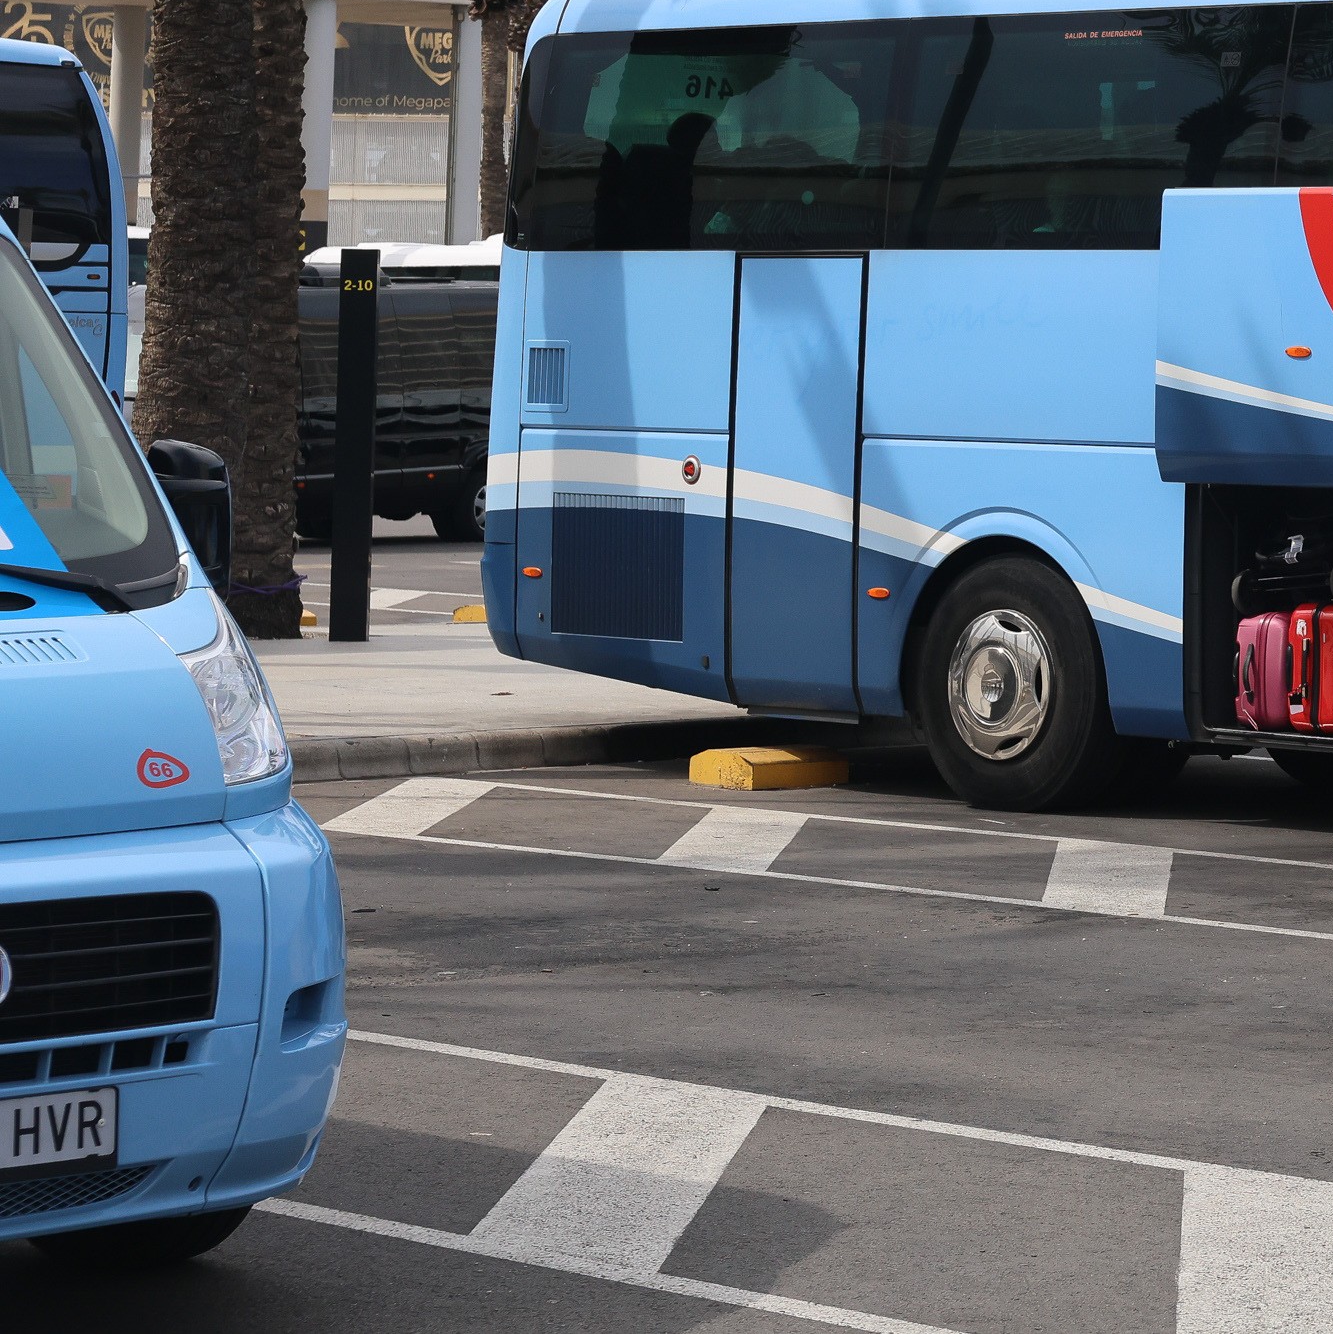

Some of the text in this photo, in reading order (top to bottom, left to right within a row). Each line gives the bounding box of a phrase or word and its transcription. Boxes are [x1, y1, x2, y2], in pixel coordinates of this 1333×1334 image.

[420, 32, 452, 49] MEG
[1064, 29, 1143, 40] SALIDA DE EMERGENCIA
[375, 94, 391, 107] of
[393, 95, 451, 110] Megapa
[344, 279, 373, 291] 2-10
[149, 762, 173, 778] 66
[13, 1100, 103, 1158] HVR
